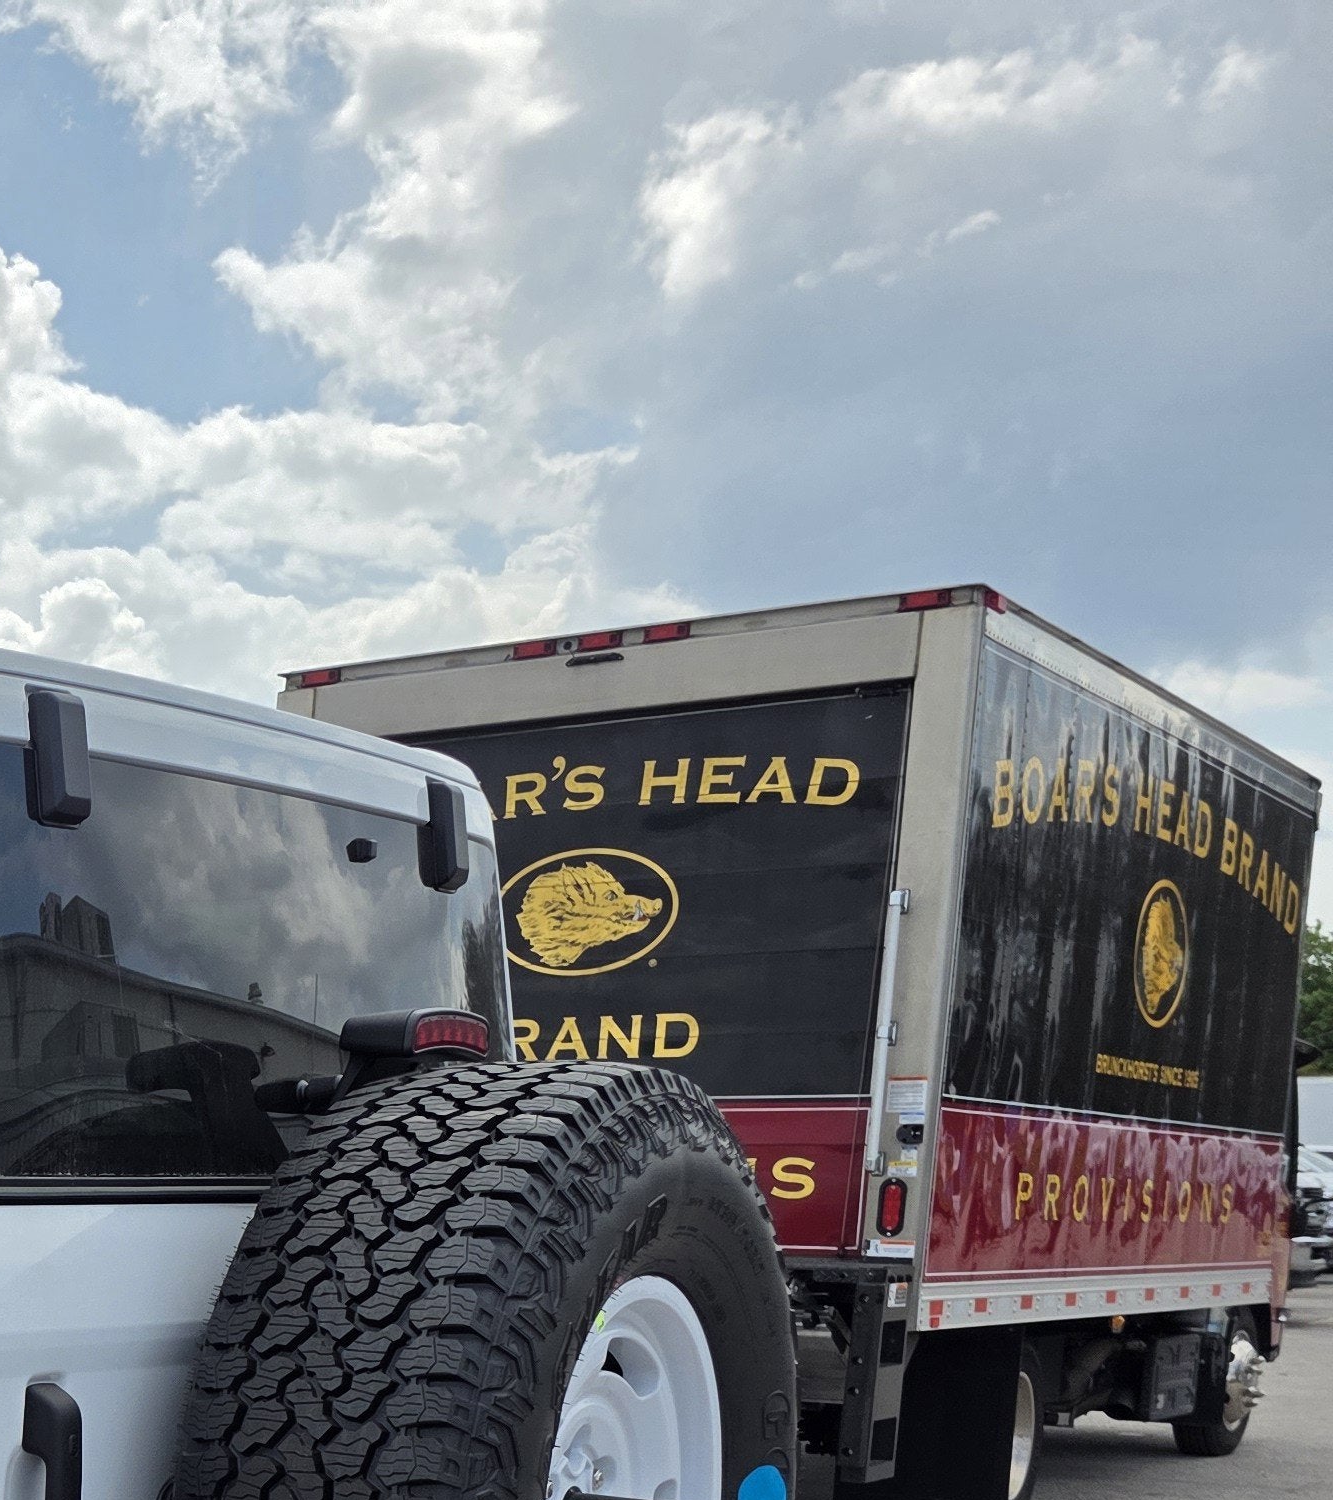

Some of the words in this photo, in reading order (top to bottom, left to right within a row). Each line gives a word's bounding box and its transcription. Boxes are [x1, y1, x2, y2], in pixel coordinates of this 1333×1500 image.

[490, 755, 606, 821] R'S
[637, 754, 861, 806] HEAD
[1134, 771, 1213, 859] HEAD
[1220, 817, 1301, 935] BRAND
[513, 1011, 700, 1062] RAND
[1014, 1171, 1234, 1224] PROVISIONS
